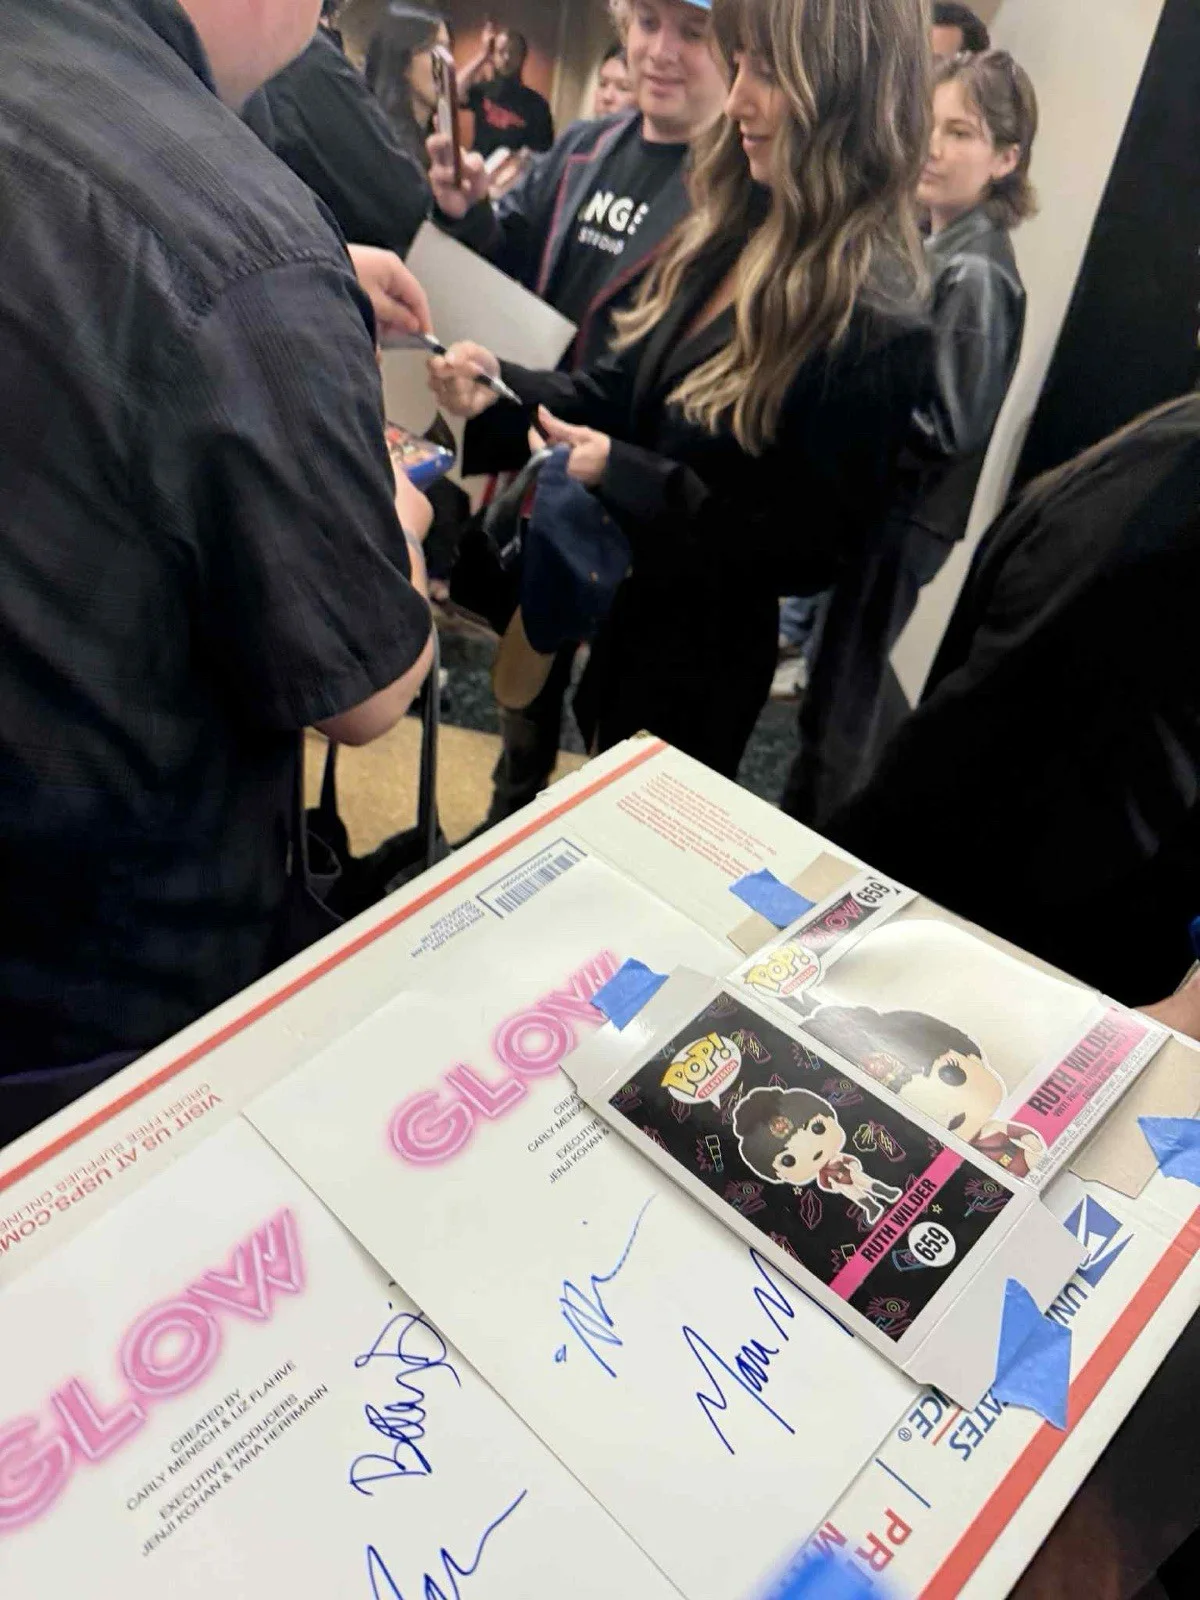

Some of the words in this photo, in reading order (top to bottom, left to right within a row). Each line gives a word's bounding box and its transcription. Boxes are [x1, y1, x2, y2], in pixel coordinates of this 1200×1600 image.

[856, 881, 890, 903] 659
[744, 941, 811, 993] POP!
[661, 1032, 731, 1098] POP!
[175, 1093, 223, 1132] VISIT
[553, 1094, 579, 1115] CREA
[1026, 1068, 1076, 1116] RUTH
[126, 1115, 162, 1143] FREE
[142, 1127, 172, 1151] US
[527, 1126, 555, 1152] CARLY
[555, 1101, 587, 1129] MENSC
[556, 1117, 601, 1159] EXECUTIVE
[56, 1142, 125, 1193] SUPPLIES
[116, 1147, 138, 1173] AT
[549, 1159, 573, 1184] JENJI
[571, 1133, 602, 1162] KOHAN
[861, 1224, 897, 1263] RUTH
[890, 1178, 937, 1227] WILDER
[914, 1226, 950, 1261] 659
[0, 1209, 305, 1527] GLOW
[126, 1472, 165, 1510] CARLY
[168, 1426, 222, 1475] MENSCH
[221, 1418, 232, 1430] &
[231, 1399, 249, 1420] LIZ
[249, 1360, 296, 1403] FLAHIVE
[171, 1404, 224, 1454] CREATED
[224, 1388, 241, 1407] BY
[142, 1521, 176, 1557] JENJI
[176, 1481, 222, 1524] KOHAN
[222, 1472, 233, 1483] &
[232, 1444, 264, 1472] TARA
[263, 1383, 329, 1446] HERRMANN
[159, 1457, 225, 1520] EXECUTIVE
[225, 1393, 299, 1460] PRODUCERS
